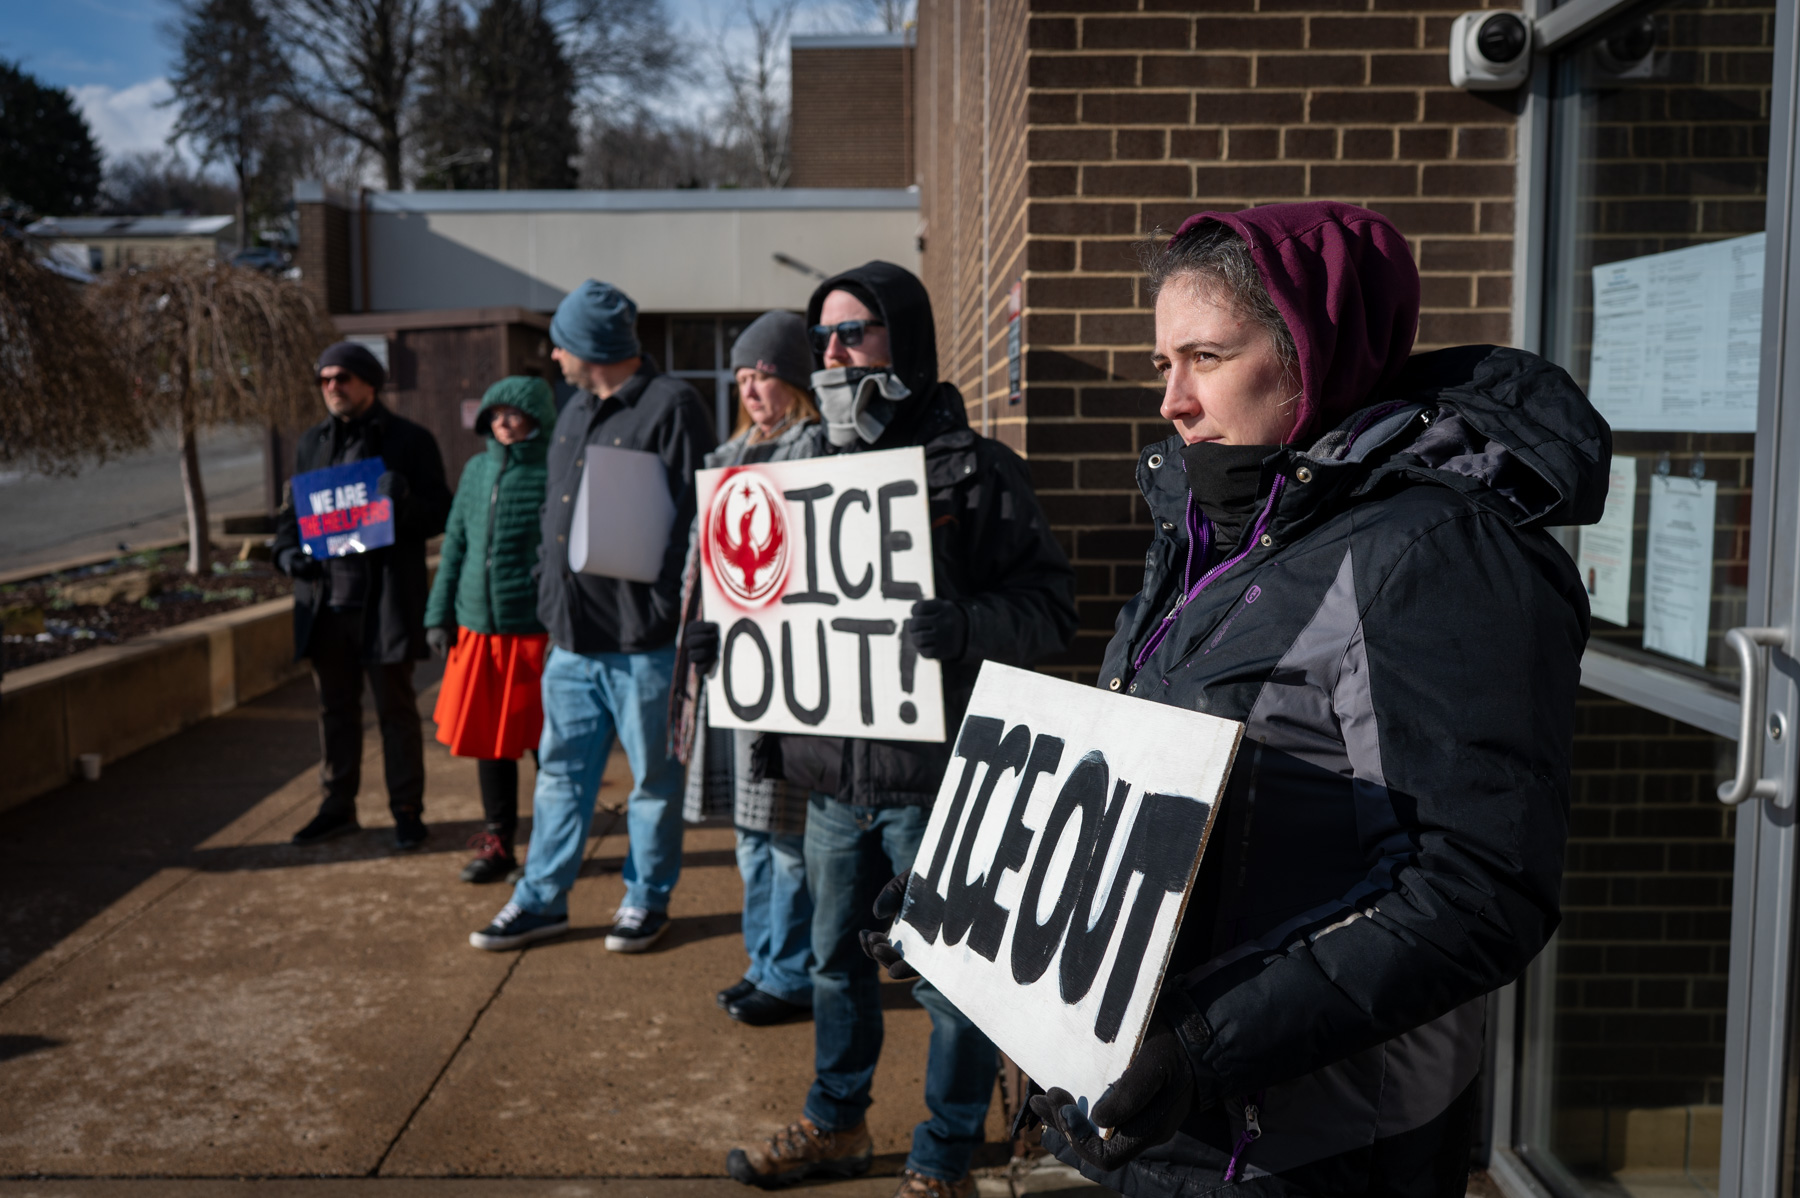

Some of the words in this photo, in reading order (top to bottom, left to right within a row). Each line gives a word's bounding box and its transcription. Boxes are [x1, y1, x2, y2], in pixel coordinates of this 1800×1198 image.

[298, 515, 322, 539] THE
[322, 498, 390, 535] HELPERS
[309, 489, 334, 515] WE
[335, 482, 368, 511] ARE
[781, 480, 925, 606] ICE
[722, 617, 918, 727] OUT!
